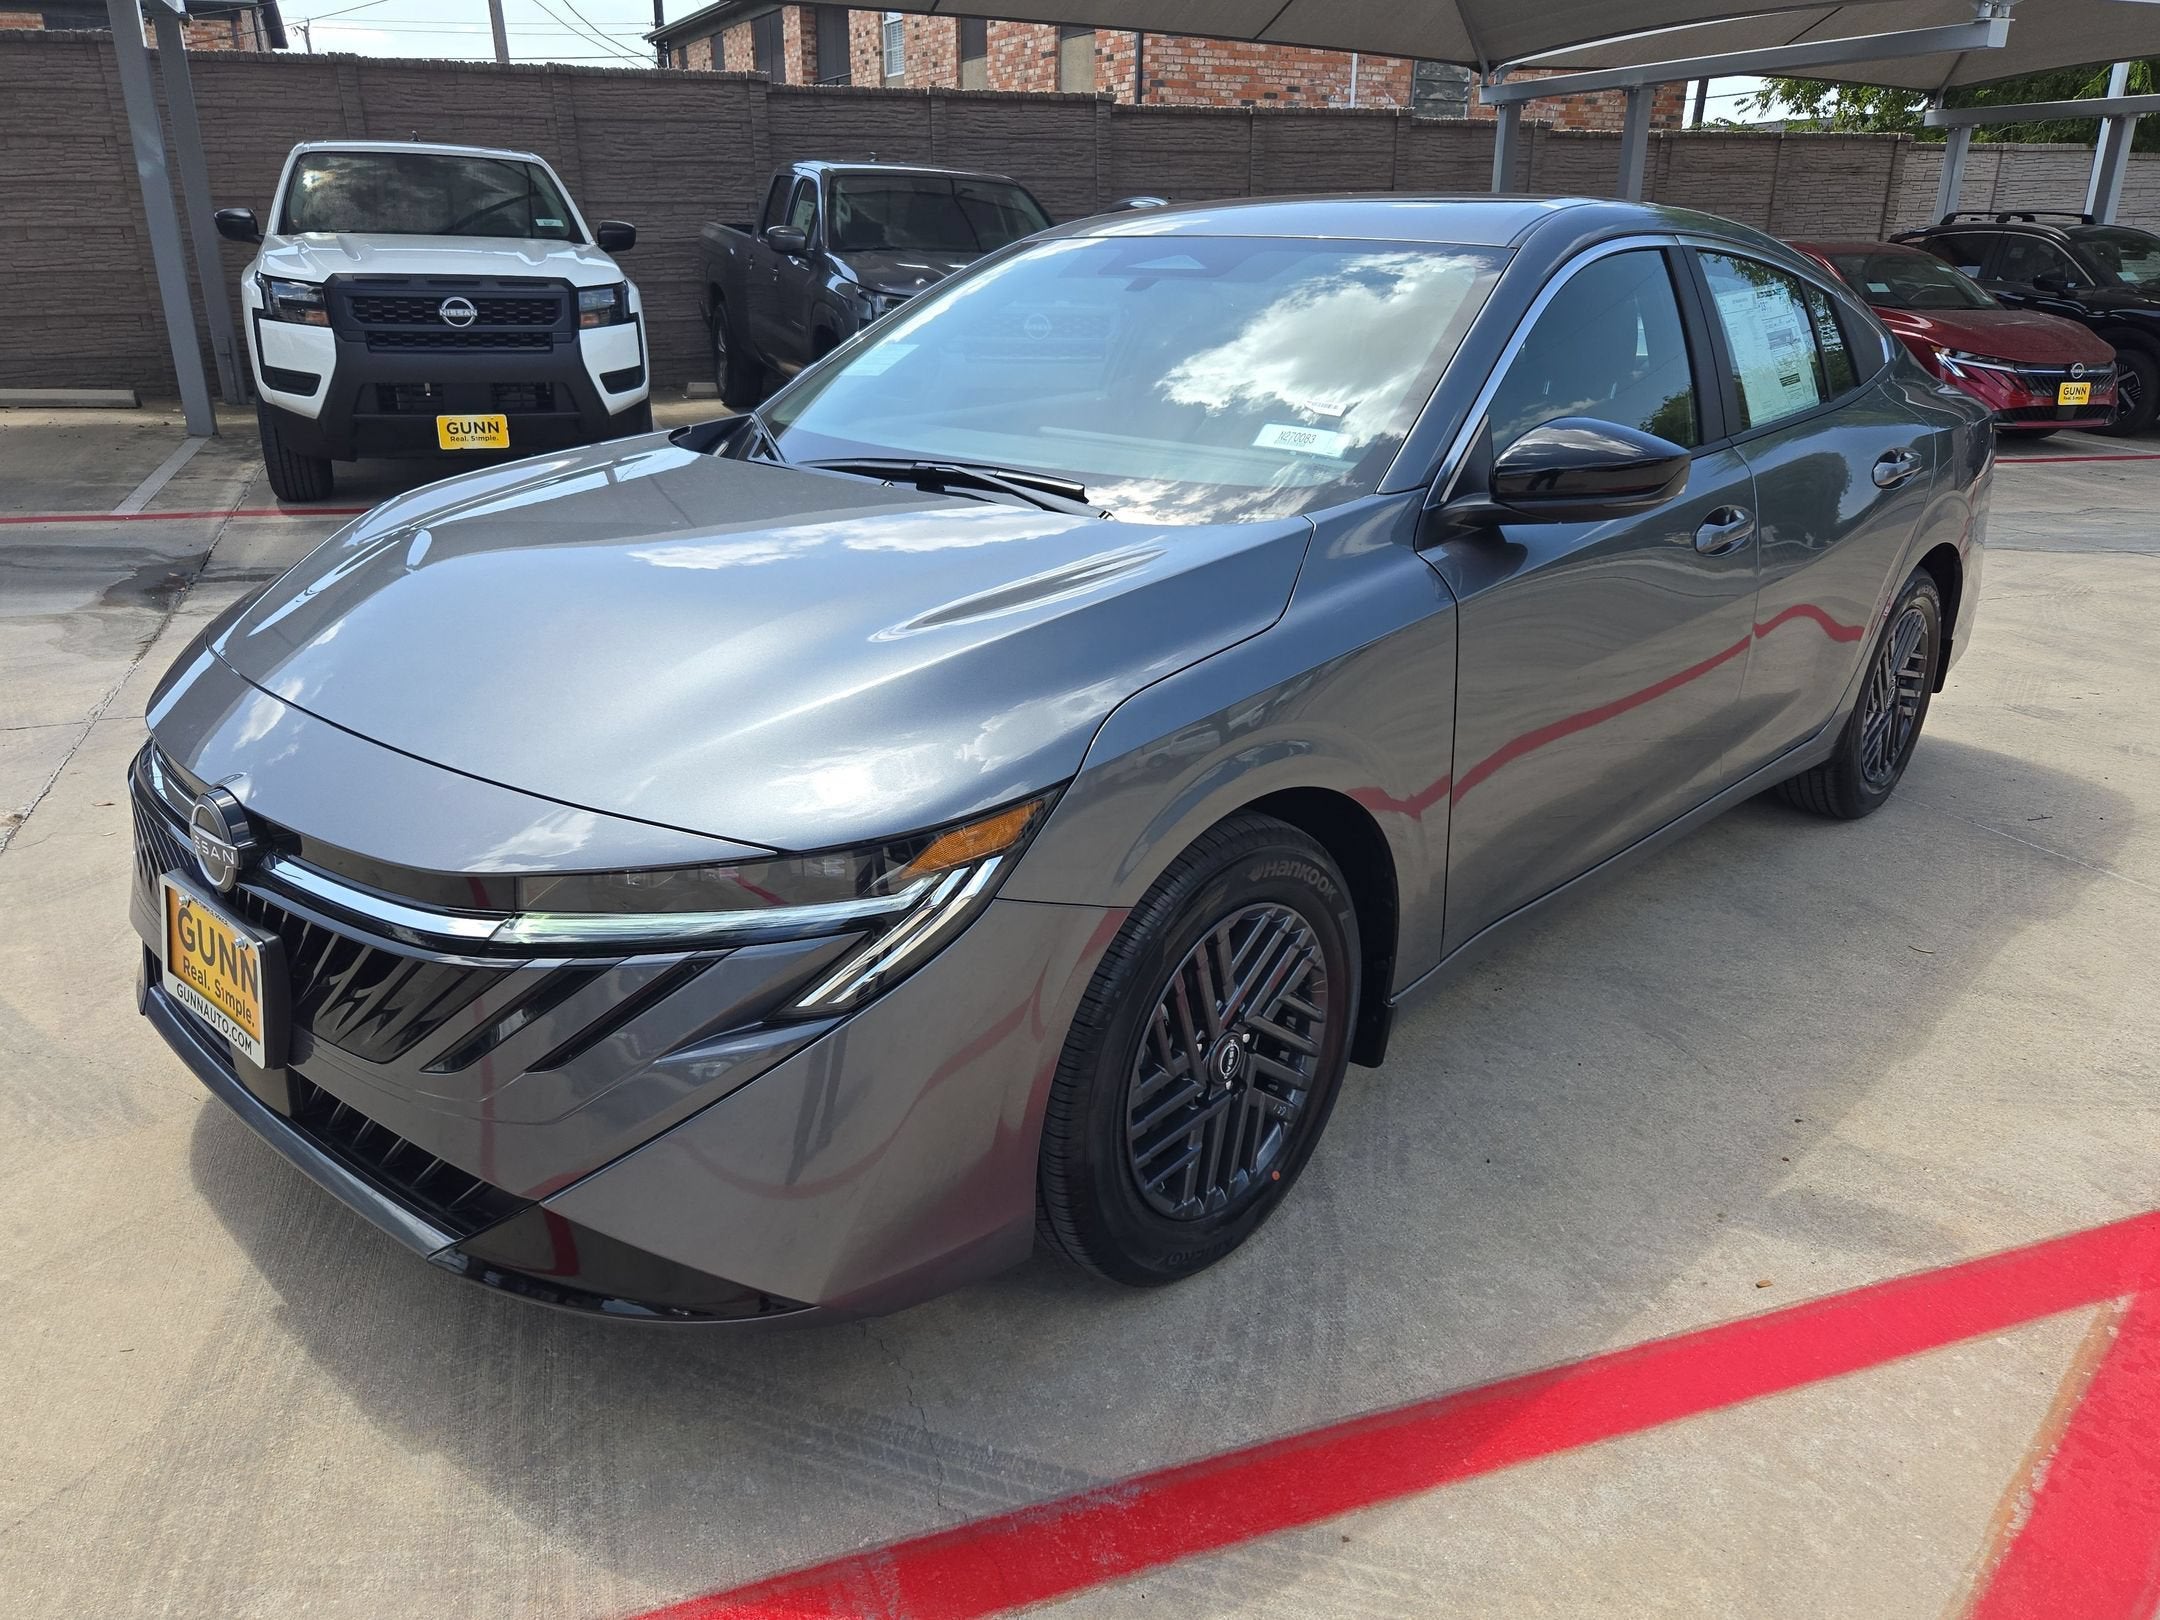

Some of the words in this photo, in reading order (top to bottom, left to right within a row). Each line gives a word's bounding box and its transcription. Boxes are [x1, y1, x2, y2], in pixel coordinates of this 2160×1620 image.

[439, 308, 478, 317] NISSAN
[2064, 387, 2087, 396] GUNN
[446, 420, 500, 434] GUNN
[178, 907, 259, 1004] GUNN
[183, 955, 211, 991] Real.
[176, 983, 252, 1055] GUNNAUTO.COM
